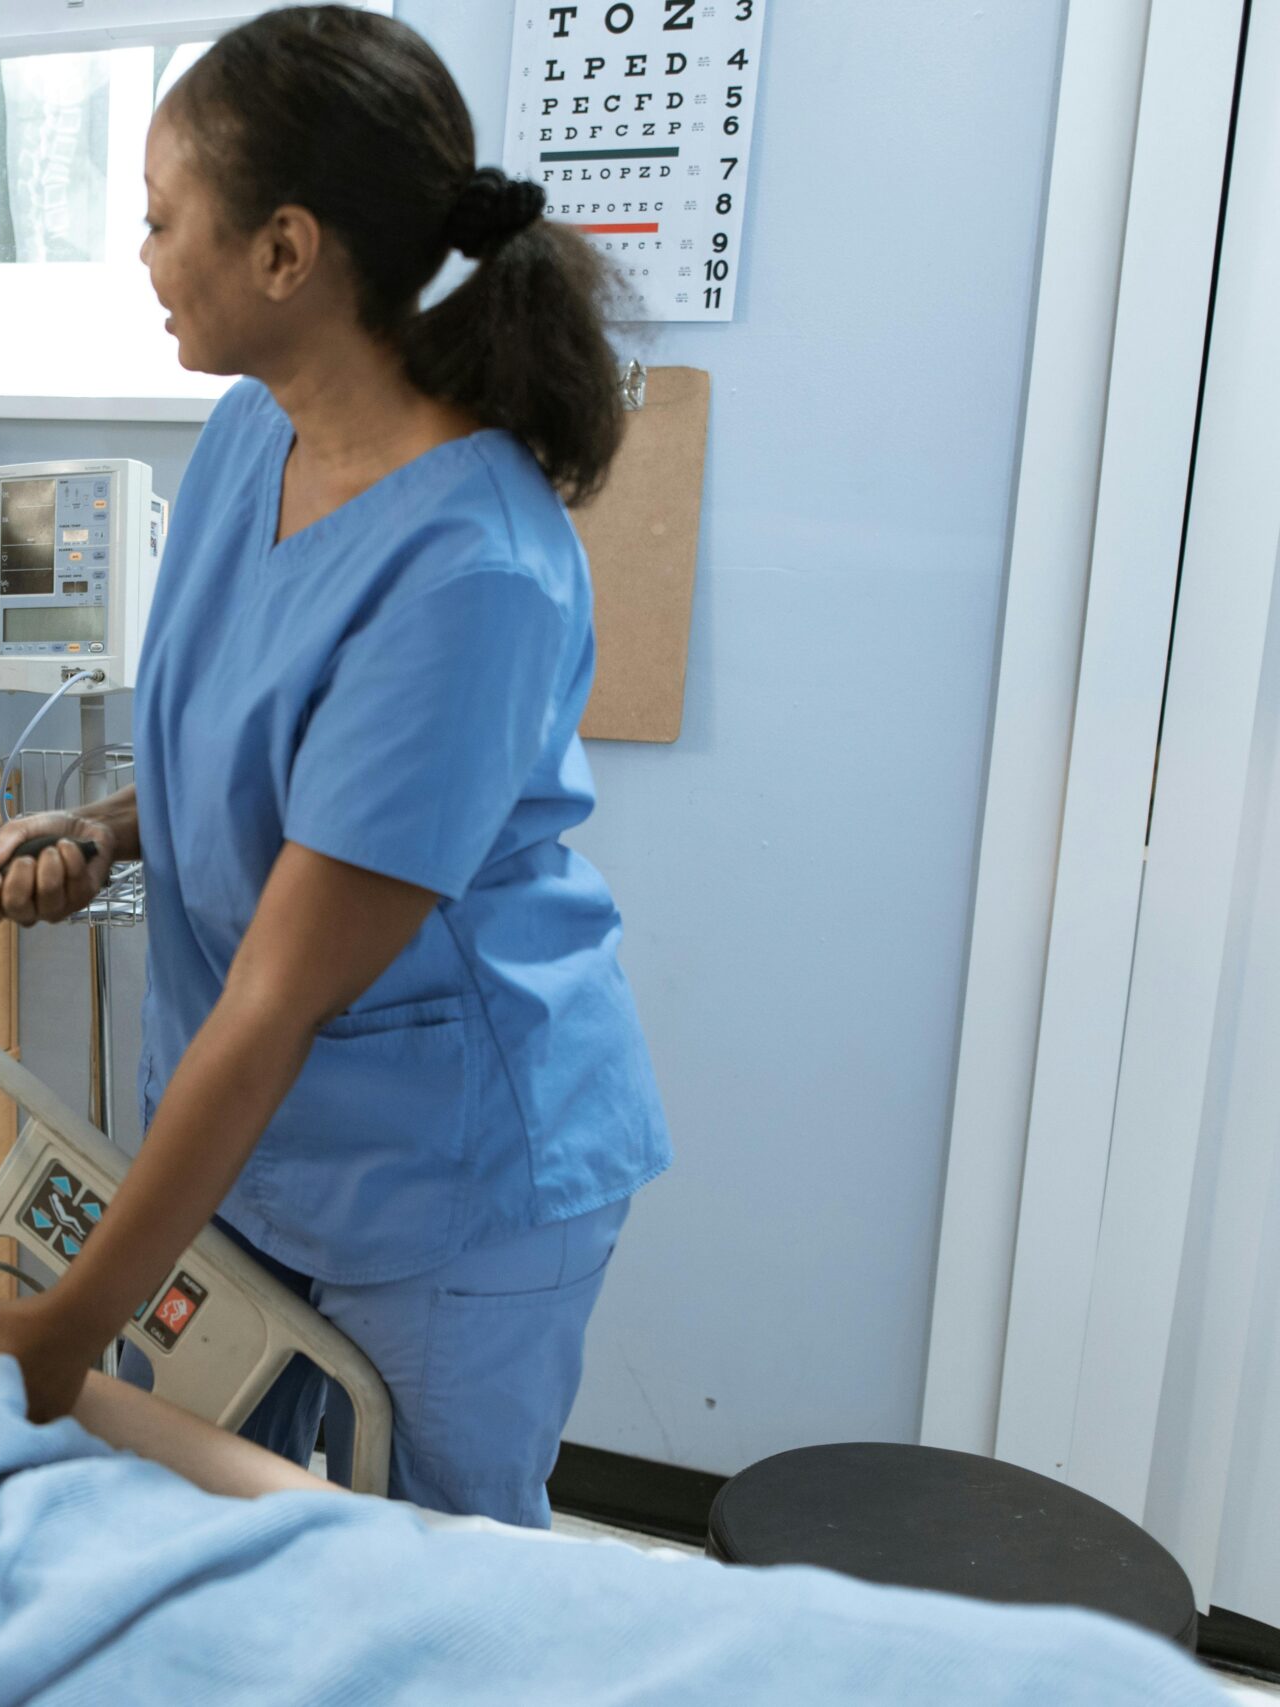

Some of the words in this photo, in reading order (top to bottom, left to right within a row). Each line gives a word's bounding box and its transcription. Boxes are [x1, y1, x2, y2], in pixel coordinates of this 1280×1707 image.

[549, 6, 578, 38] T
[605, 2, 634, 34] O
[663, 0, 696, 31] Z
[734, 0, 753, 21] 3
[544, 59, 565, 81] L
[583, 57, 605, 79] P
[624, 54, 647, 77] E
[665, 52, 687, 75] D
[727, 48, 749, 71] 4
[541, 98, 558, 115] P
[572, 96, 589, 114] E
[604, 95, 621, 112] C
[634, 93, 652, 111] F
[666, 92, 683, 109] D
[725, 85, 742, 108] 5
[723, 115, 739, 136] 6
[720, 157, 738, 180] 7
[715, 193, 732, 215] 8
[712, 232, 728, 253] 9
[704, 259, 729, 281] 10
[703, 287, 722, 309] 11
[150, 1325, 166, 1344] CALL
